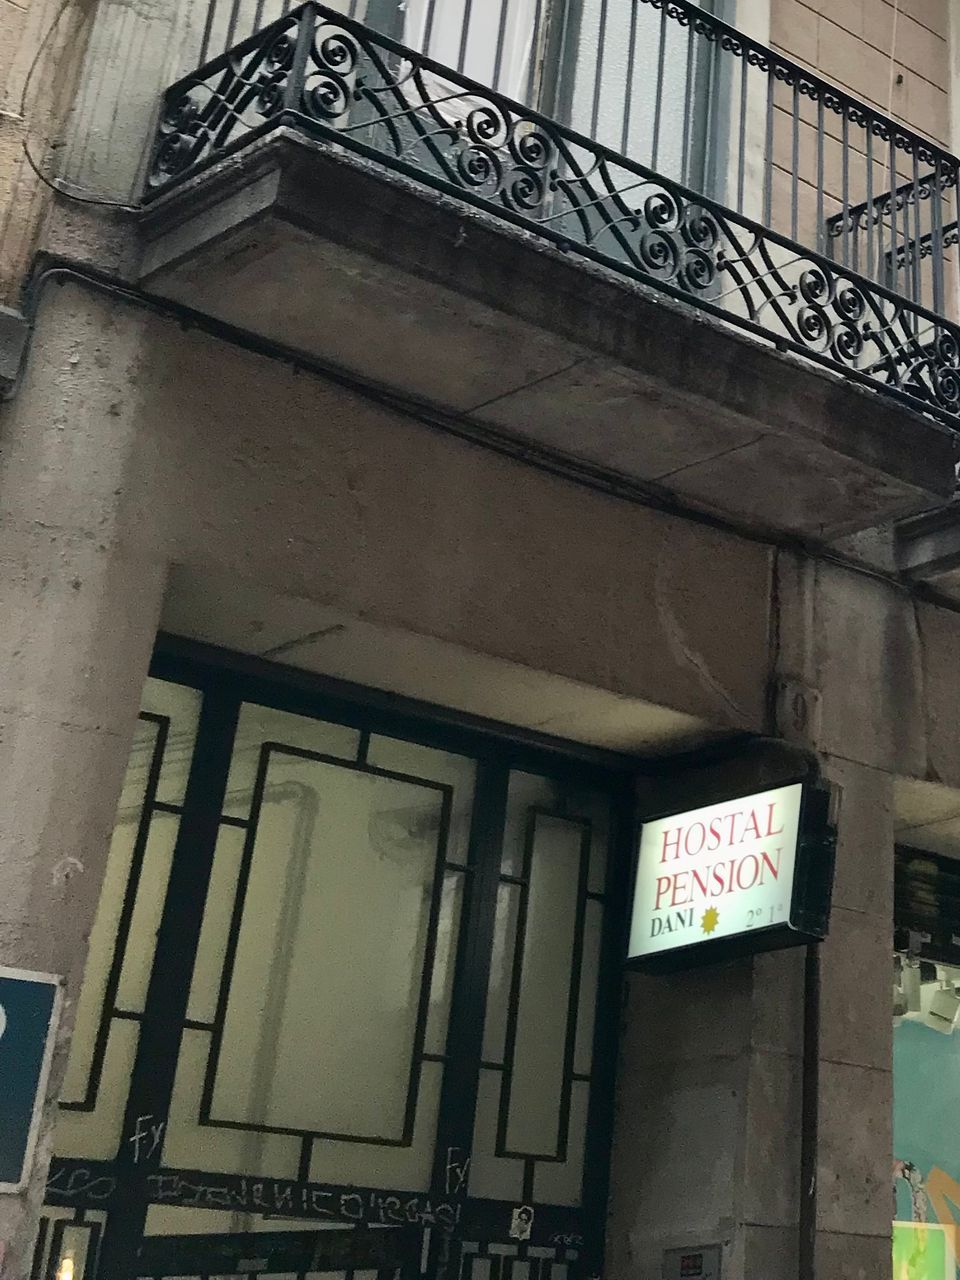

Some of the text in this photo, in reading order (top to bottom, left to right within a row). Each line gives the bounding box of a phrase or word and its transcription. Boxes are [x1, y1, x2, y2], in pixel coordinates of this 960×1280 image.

[659, 803, 784, 863] HOSTAL
[652, 847, 783, 911] PENSION
[650, 908, 694, 938] DANI
